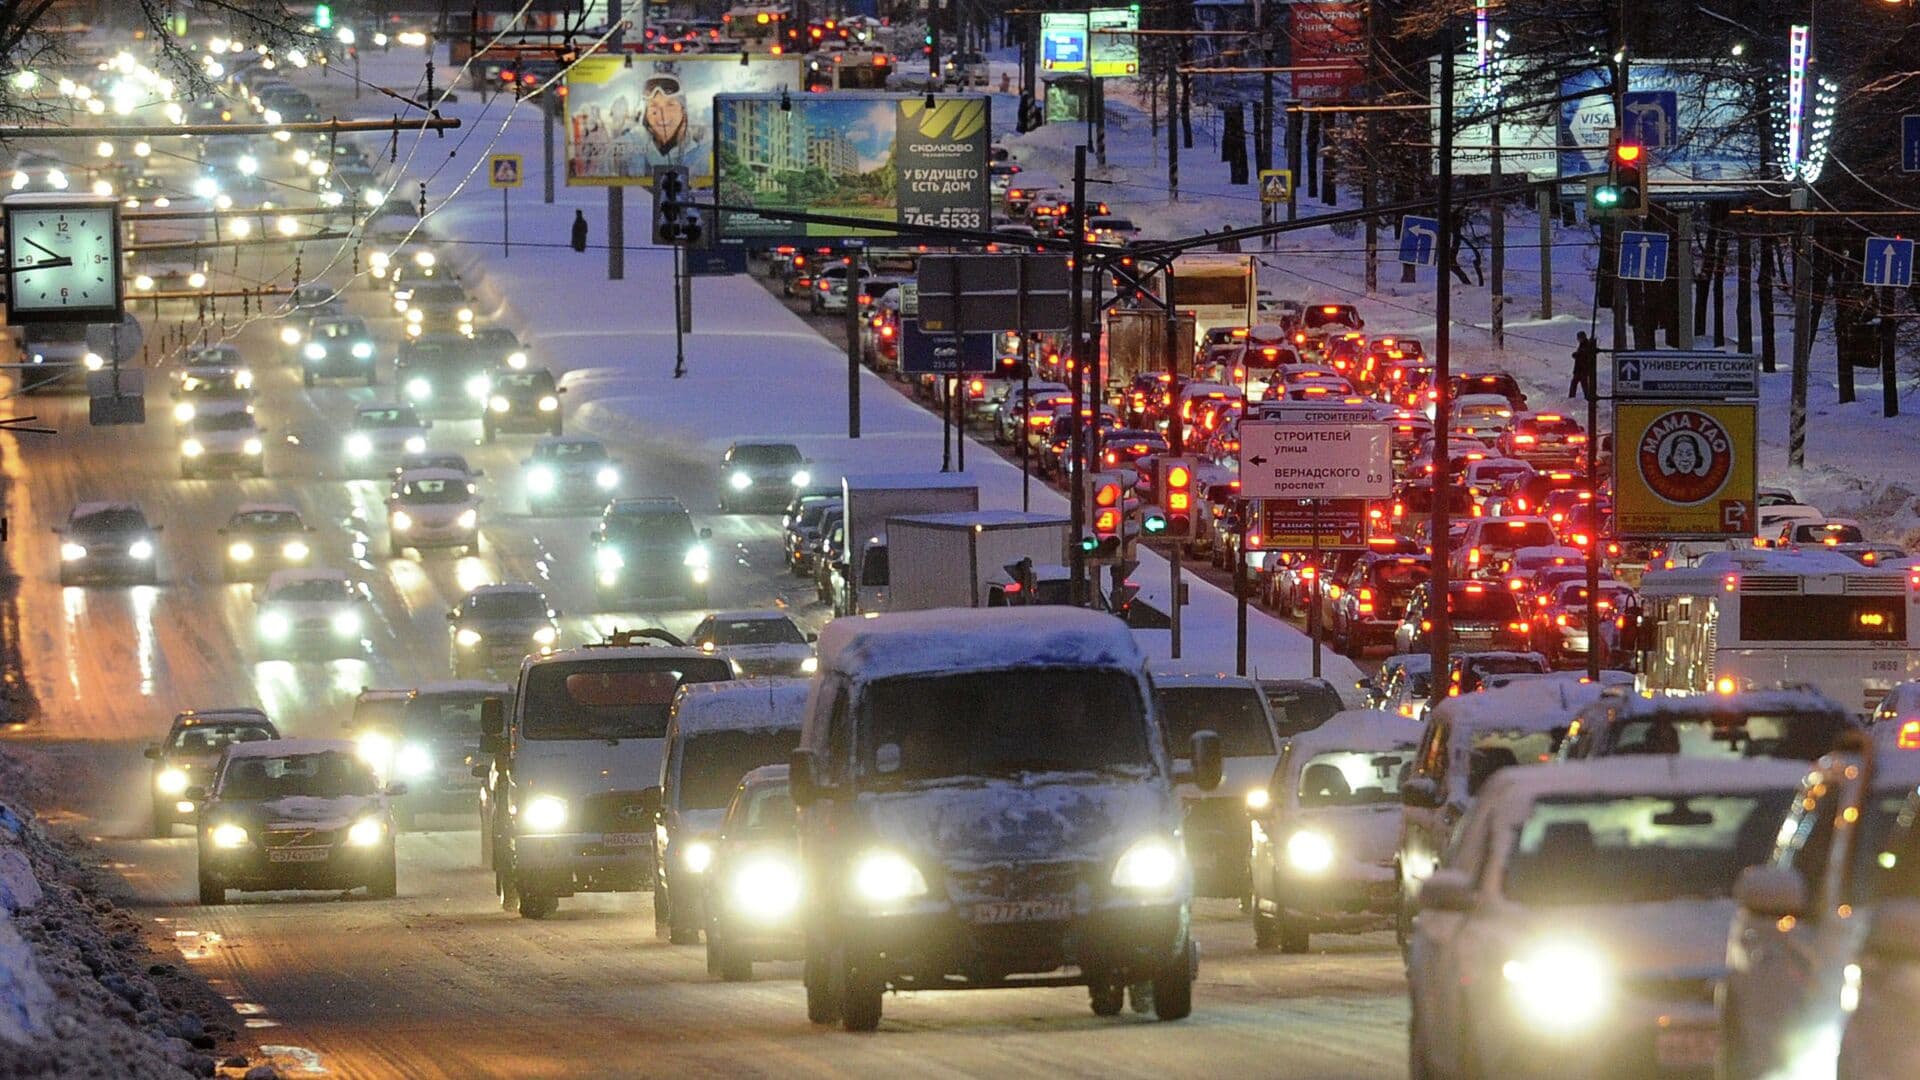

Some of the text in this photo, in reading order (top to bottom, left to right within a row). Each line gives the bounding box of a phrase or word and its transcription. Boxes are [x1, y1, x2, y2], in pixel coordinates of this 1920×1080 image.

[1581, 113, 1610, 124] VISA
[909, 144, 974, 152] СКОЛКОВО
[904, 168, 979, 182] У БУДУЩЕГО
[912, 181, 971, 194] ЕСТЬ ДОМ
[904, 214, 980, 229] 745-5533
[57, 222, 69, 232] 12
[26, 255, 33, 264] 9
[94, 255, 101, 264] 3
[61, 288, 68, 297] 6
[1642, 360, 1754, 371] УНИВЕРСИТЕТСКИЙ
[1305, 412, 1369, 421] СТРОИТЕЛЕЙ
[1274, 430, 1351, 441] СТРОИТЕЛЕЙ
[1274, 445, 1308, 454] улица
[1274, 468, 1360, 478] ВЕРНАДСКОГО
[1366, 473, 1383, 484] 0.9
[1274, 482, 1326, 492] проспект
